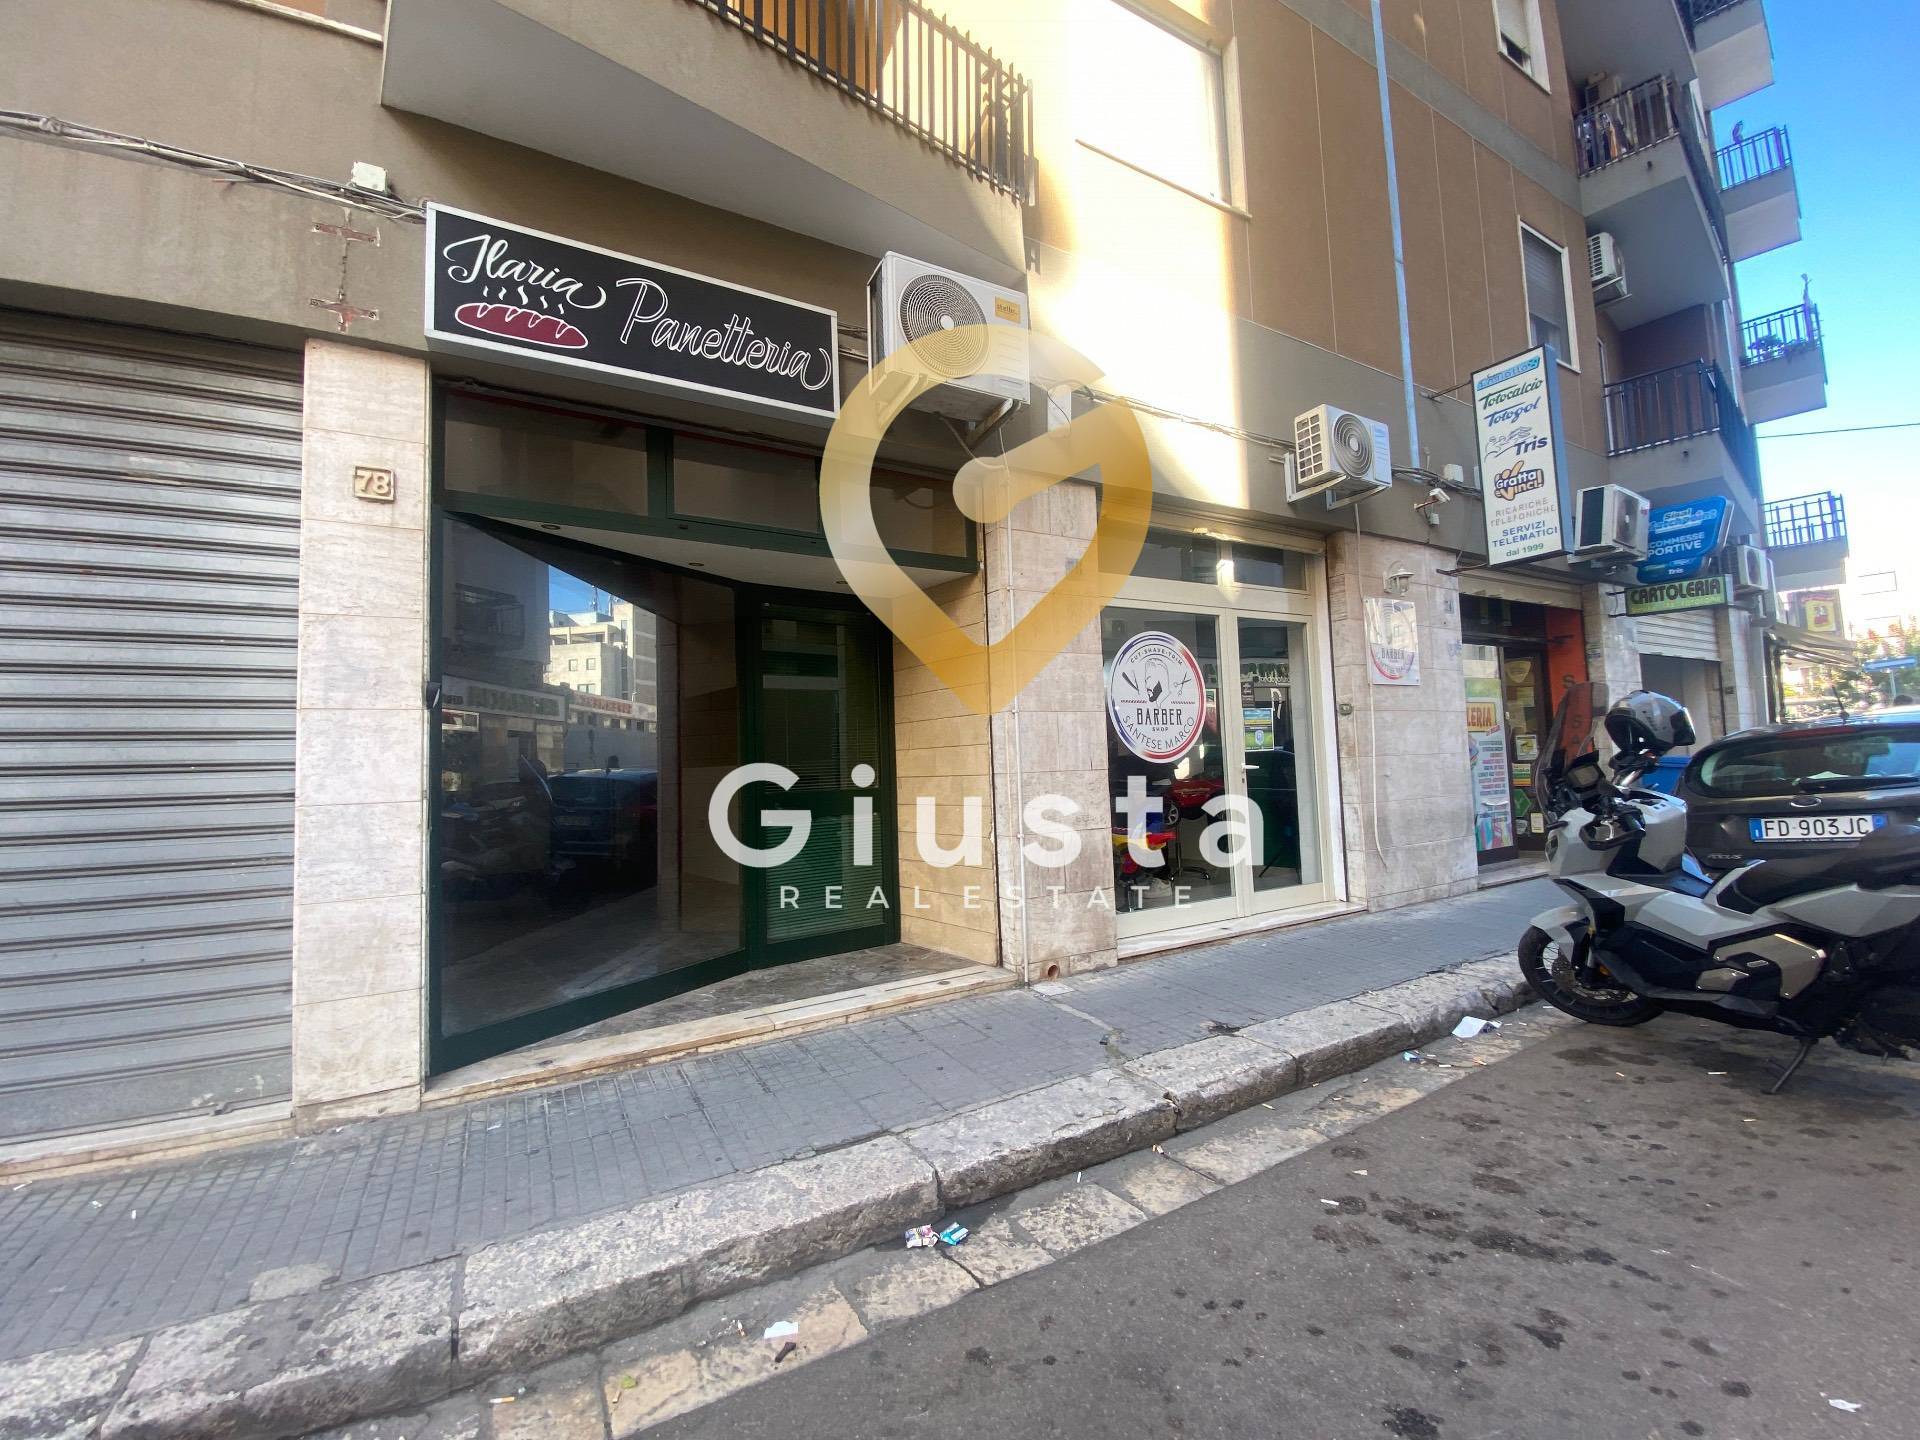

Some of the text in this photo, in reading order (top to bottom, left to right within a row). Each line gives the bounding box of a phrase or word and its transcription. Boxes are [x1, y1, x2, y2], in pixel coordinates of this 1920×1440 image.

[443, 233, 831, 390] Ilaria Panetteria
[1479, 378, 1543, 410] Totocalcio
[1484, 396, 1541, 426] Totogol
[1512, 436, 1548, 456] Tris
[354, 472, 391, 495] 78
[1496, 471, 1537, 489] Gratta
[1490, 505, 1556, 527] TELEFONICHE
[1495, 498, 1549, 517] RICARICHE
[1664, 508, 1693, 520] Sisal
[1492, 526, 1558, 548] TELEMATICI
[1502, 521, 1545, 537] SERVIZI
[1648, 532, 1705, 548] COMMESSE
[1648, 540, 1702, 557] PORTIVE
[1506, 543, 1544, 557] dal 1999
[1630, 579, 1720, 604] CARTOLERIA
[1137, 707, 1182, 726] BARBER
[1123, 715, 1195, 750] SANTESE MARCO
[1764, 820, 1790, 837] FD
